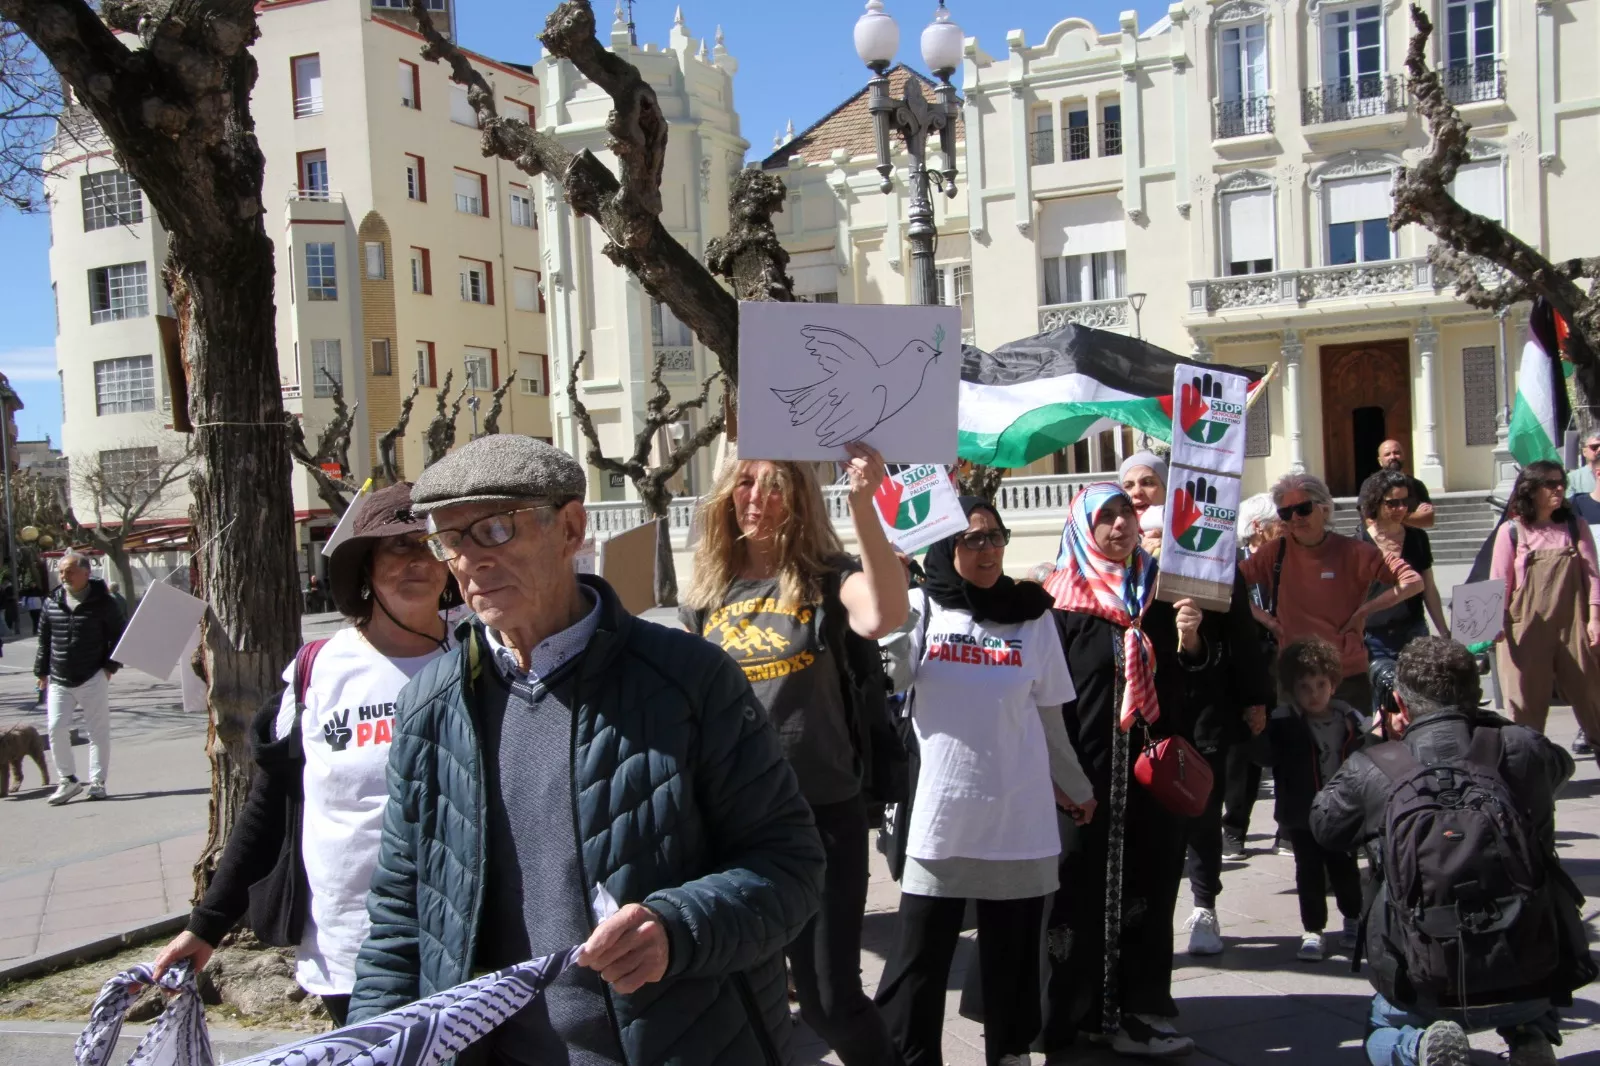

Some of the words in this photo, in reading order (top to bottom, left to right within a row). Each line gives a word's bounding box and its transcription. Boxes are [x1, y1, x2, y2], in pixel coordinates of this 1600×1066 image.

[1212, 401, 1242, 414] STOP
[1212, 416, 1241, 425] PALESTINO
[903, 464, 936, 485] STOP
[910, 480, 940, 496] PALESTINO
[1204, 506, 1236, 520] STOP
[1204, 522, 1234, 532] PALESTINO
[933, 633, 977, 645] HUESCA
[983, 637, 1002, 648] CON
[928, 643, 1023, 667] PALESTINA
[741, 650, 814, 682] ENIDXS
[357, 718, 396, 747] PA
